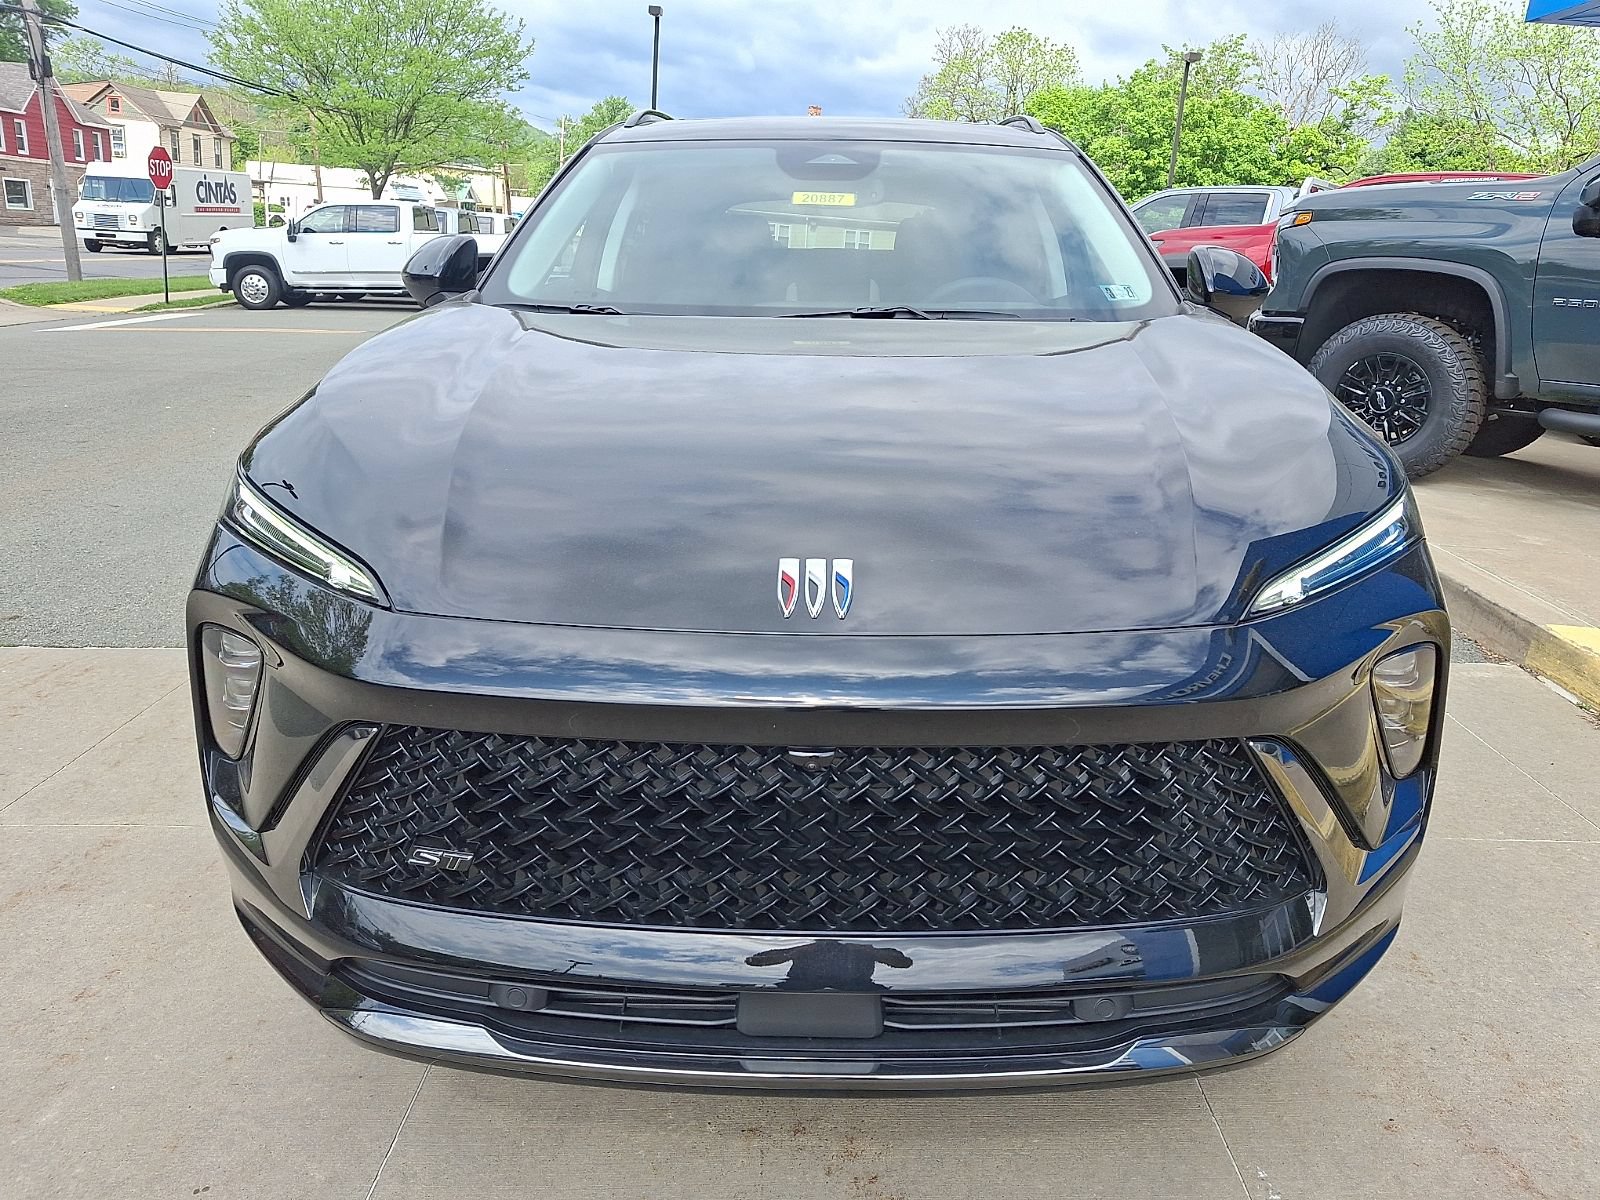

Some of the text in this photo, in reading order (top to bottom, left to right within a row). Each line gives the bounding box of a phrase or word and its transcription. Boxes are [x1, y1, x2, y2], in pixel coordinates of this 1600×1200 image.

[150, 159, 171, 176] STOP
[196, 174, 237, 204] CINTAS
[1466, 191, 1542, 201] ZR2
[802, 194, 845, 203] 20887
[1552, 297, 1600, 308] 250
[407, 848, 474, 871] ST
